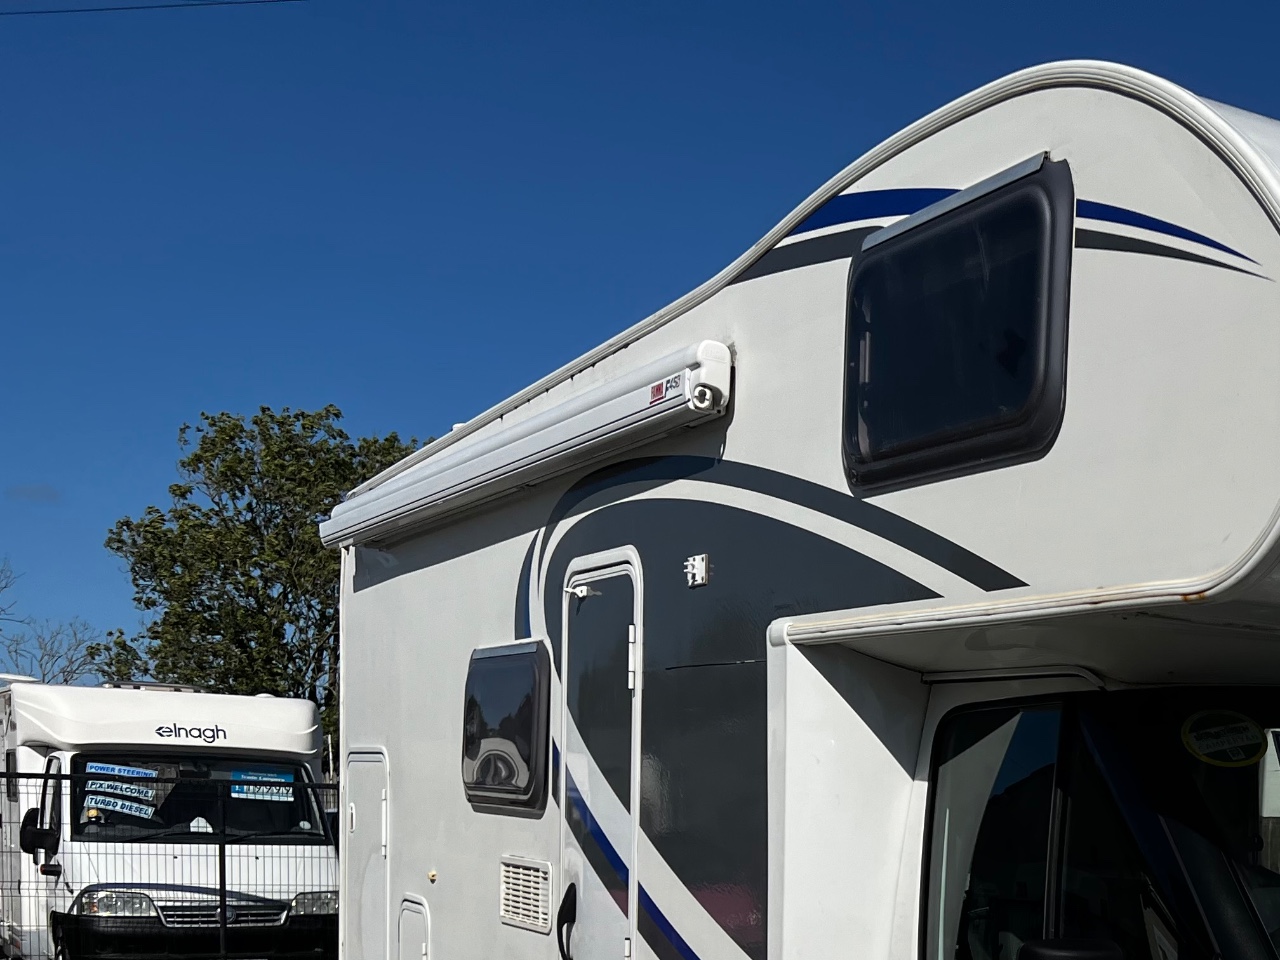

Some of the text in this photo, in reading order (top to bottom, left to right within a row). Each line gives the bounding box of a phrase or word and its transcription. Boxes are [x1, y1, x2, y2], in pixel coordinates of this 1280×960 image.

[155, 723, 227, 744] elnagh
[89, 765, 116, 773] POWER
[107, 783, 150, 797] WELCOME
[89, 797, 150, 816] TURBO DIESEL
